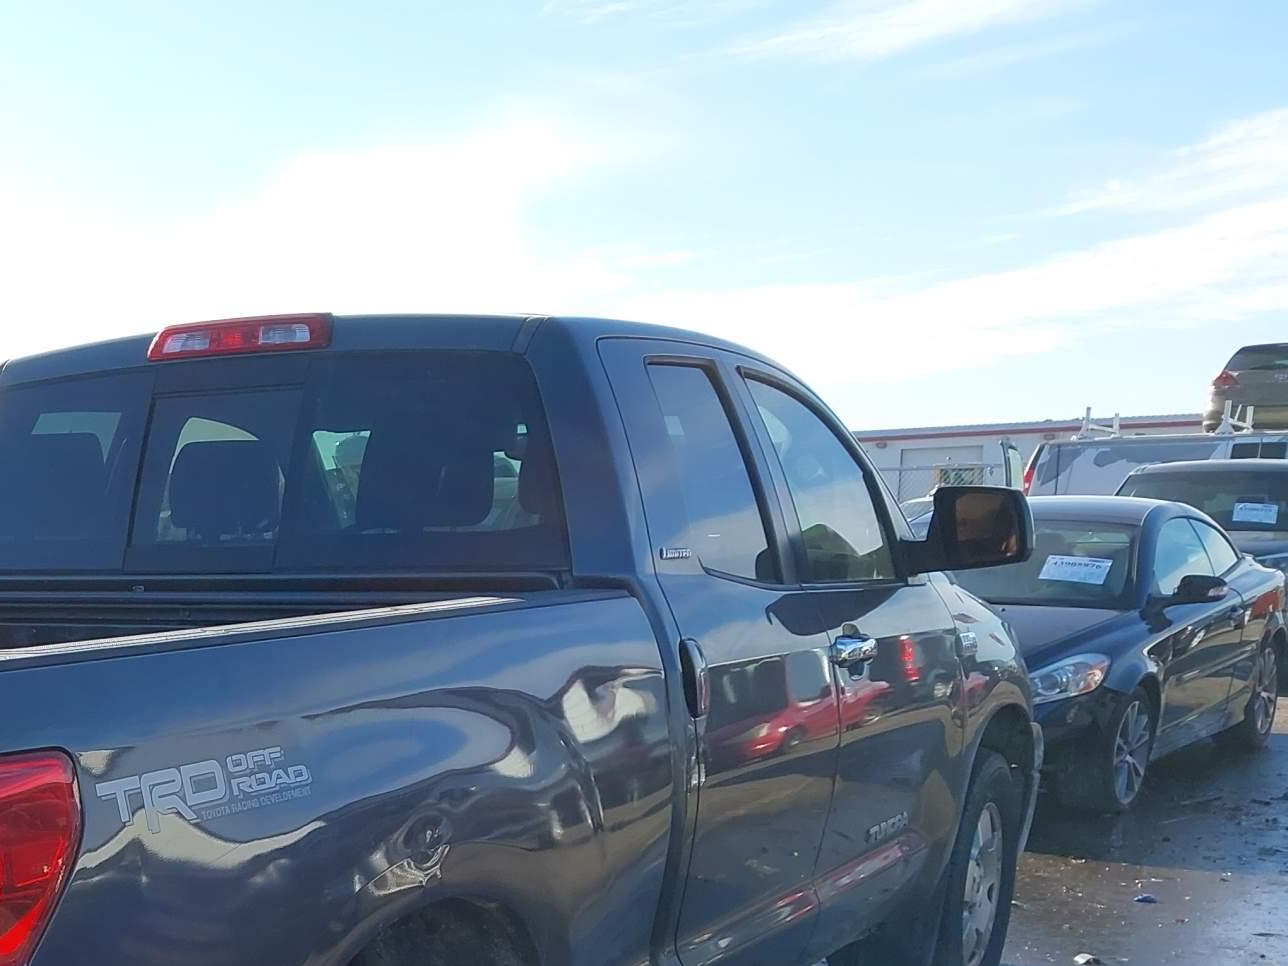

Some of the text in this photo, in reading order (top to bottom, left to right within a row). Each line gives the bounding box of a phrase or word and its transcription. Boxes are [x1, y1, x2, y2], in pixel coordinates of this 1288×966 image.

[226, 746, 284, 772] OFF
[96, 759, 226, 834] TRD
[230, 764, 312, 797] ROAD
